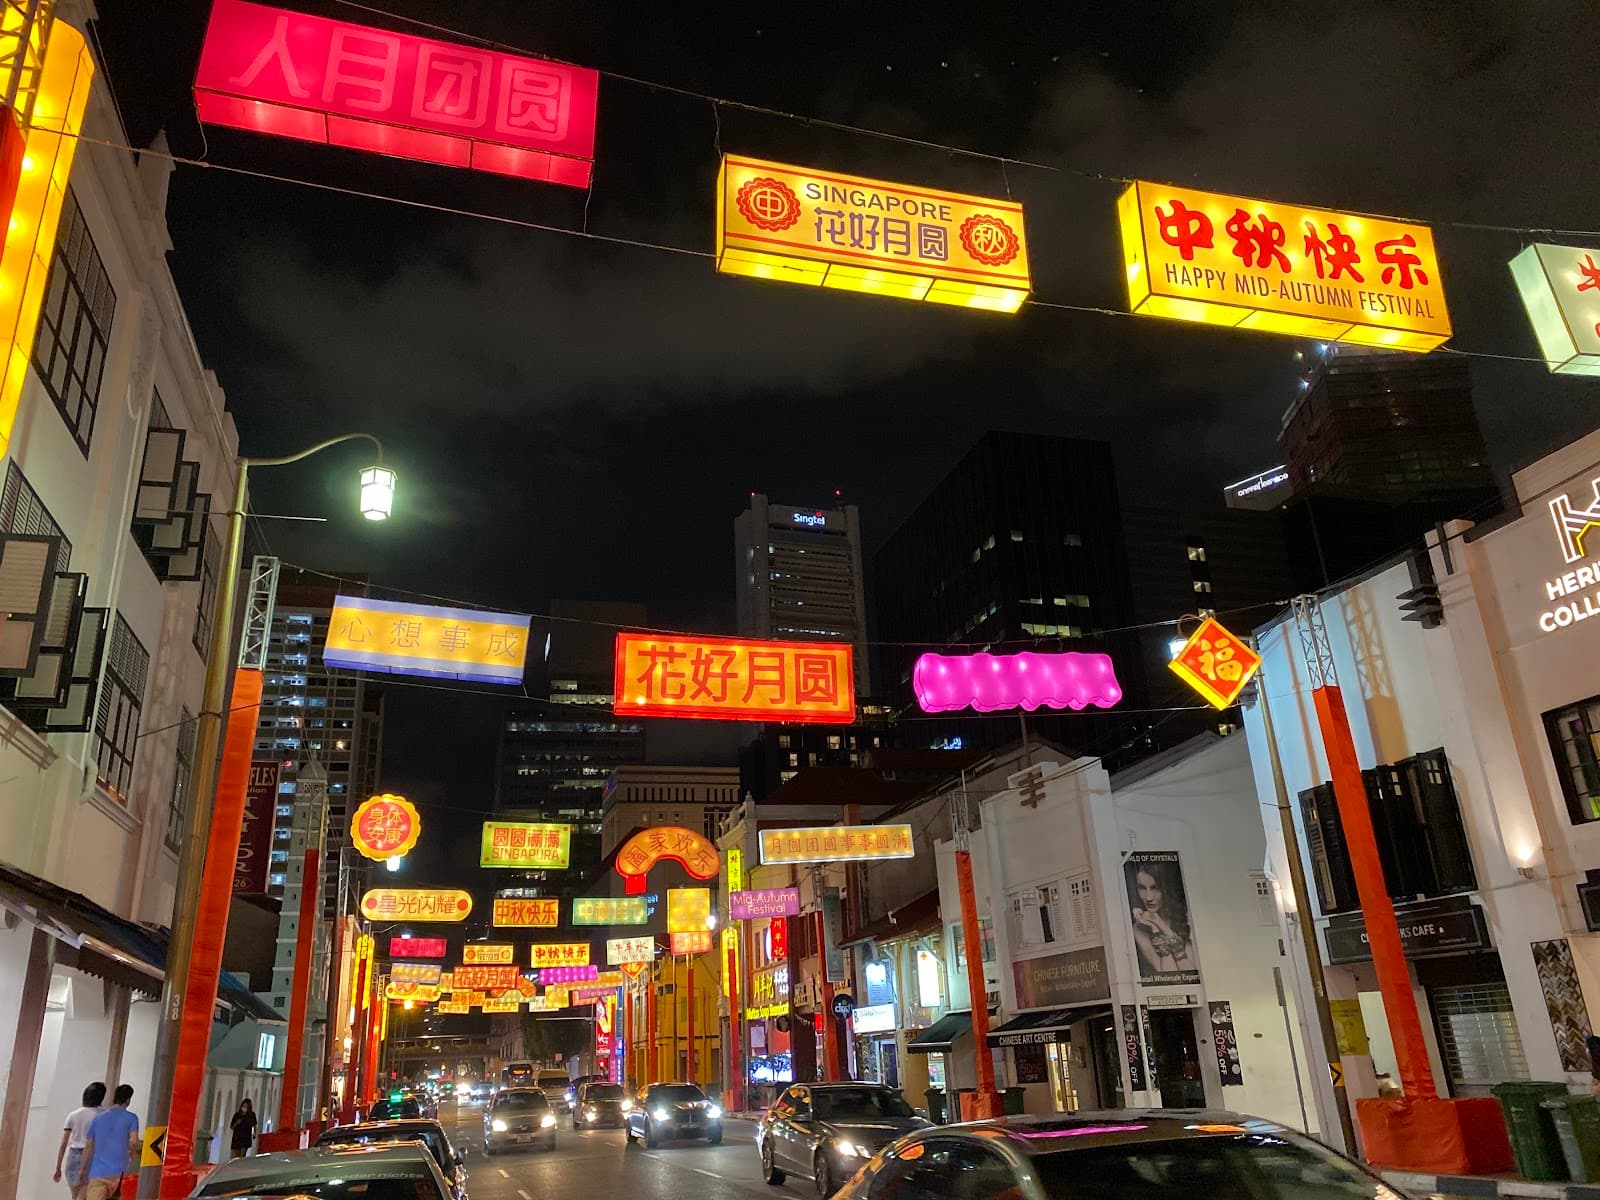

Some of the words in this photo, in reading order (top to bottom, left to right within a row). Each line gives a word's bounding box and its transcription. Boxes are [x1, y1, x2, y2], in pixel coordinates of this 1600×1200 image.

[228, 15, 573, 142] 人月团圆
[805, 183, 953, 222] SINGAPORE
[814, 206, 949, 262] 花好月圆
[1155, 200, 1429, 290] 中秋快乐
[1165, 263, 1226, 291] HAPPY
[1234, 269, 1354, 308] MID-AUTUMN
[1360, 291, 1435, 319] FESTIVAL
[793, 512, 826, 526] Singtel
[1546, 561, 1600, 601] HERI
[1539, 591, 1600, 632] COLL
[340, 616, 519, 659] 心想事成
[1197, 637, 1244, 682] 福
[636, 645, 839, 706] 花好月圆
[367, 808, 404, 827] 身体
[366, 826, 402, 844] 安康
[492, 848, 560, 860] SINGAPURA
[378, 895, 456, 914] 星光闪耀
[733, 892, 797, 905] Mid-Autumn
[747, 903, 786, 915] Festival
[495, 901, 556, 924] 中秋快乐
[1413, 924, 1435, 937] CAFE
[1061, 959, 1100, 977] FURNITURE
[999, 1035, 1022, 1046] CHINESE
[1023, 1034, 1033, 1045] ART
[1034, 1032, 1057, 1043] CENTRE
[1126, 1035, 1139, 1063] 50%
[1214, 1030, 1227, 1057] 50%
[1130, 1066, 1139, 1084] OFF
[1219, 1058, 1228, 1075] OFF
